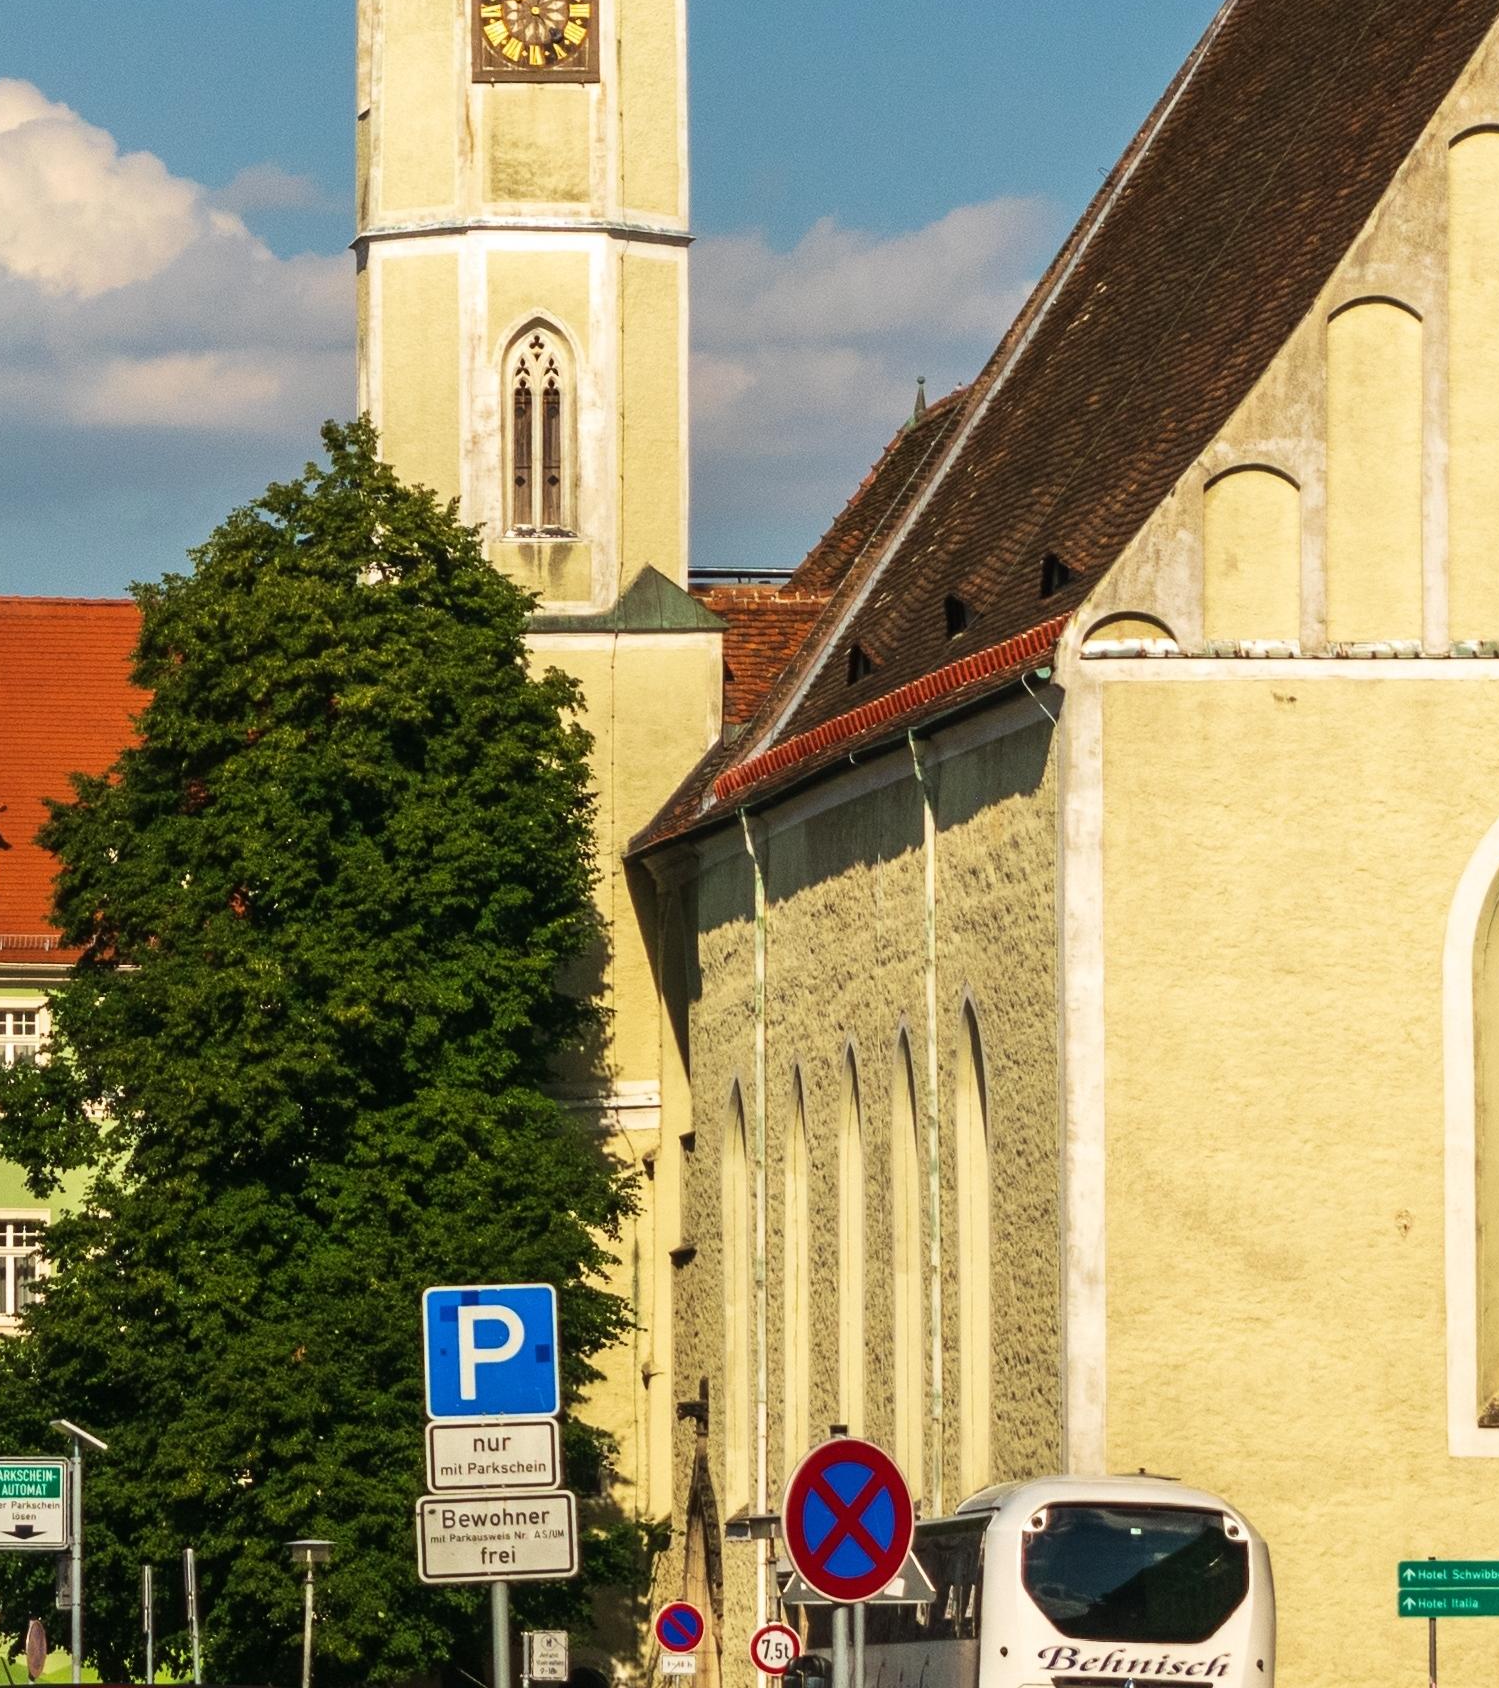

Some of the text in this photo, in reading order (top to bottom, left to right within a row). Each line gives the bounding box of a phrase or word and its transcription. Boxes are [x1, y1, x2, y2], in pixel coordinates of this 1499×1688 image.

[569, 4, 590, 18] III
[457, 1304, 525, 1401] P
[473, 1436, 512, 1452] nur
[440, 1460, 547, 1475] mit Parkschein
[1, 1483, 47, 1496] AUTOMAT
[11, 1501, 60, 1509] Parkschein
[442, 1508, 549, 1529] Bewohner
[430, 1536, 446, 1544] mit
[449, 1532, 511, 1543] Parkausweis
[480, 1545, 517, 1564] frei
[1418, 1570, 1447, 1579] Hotel
[1418, 1597, 1478, 1608] Hotel Italia
[1038, 1645, 1231, 1677] Behnisch
